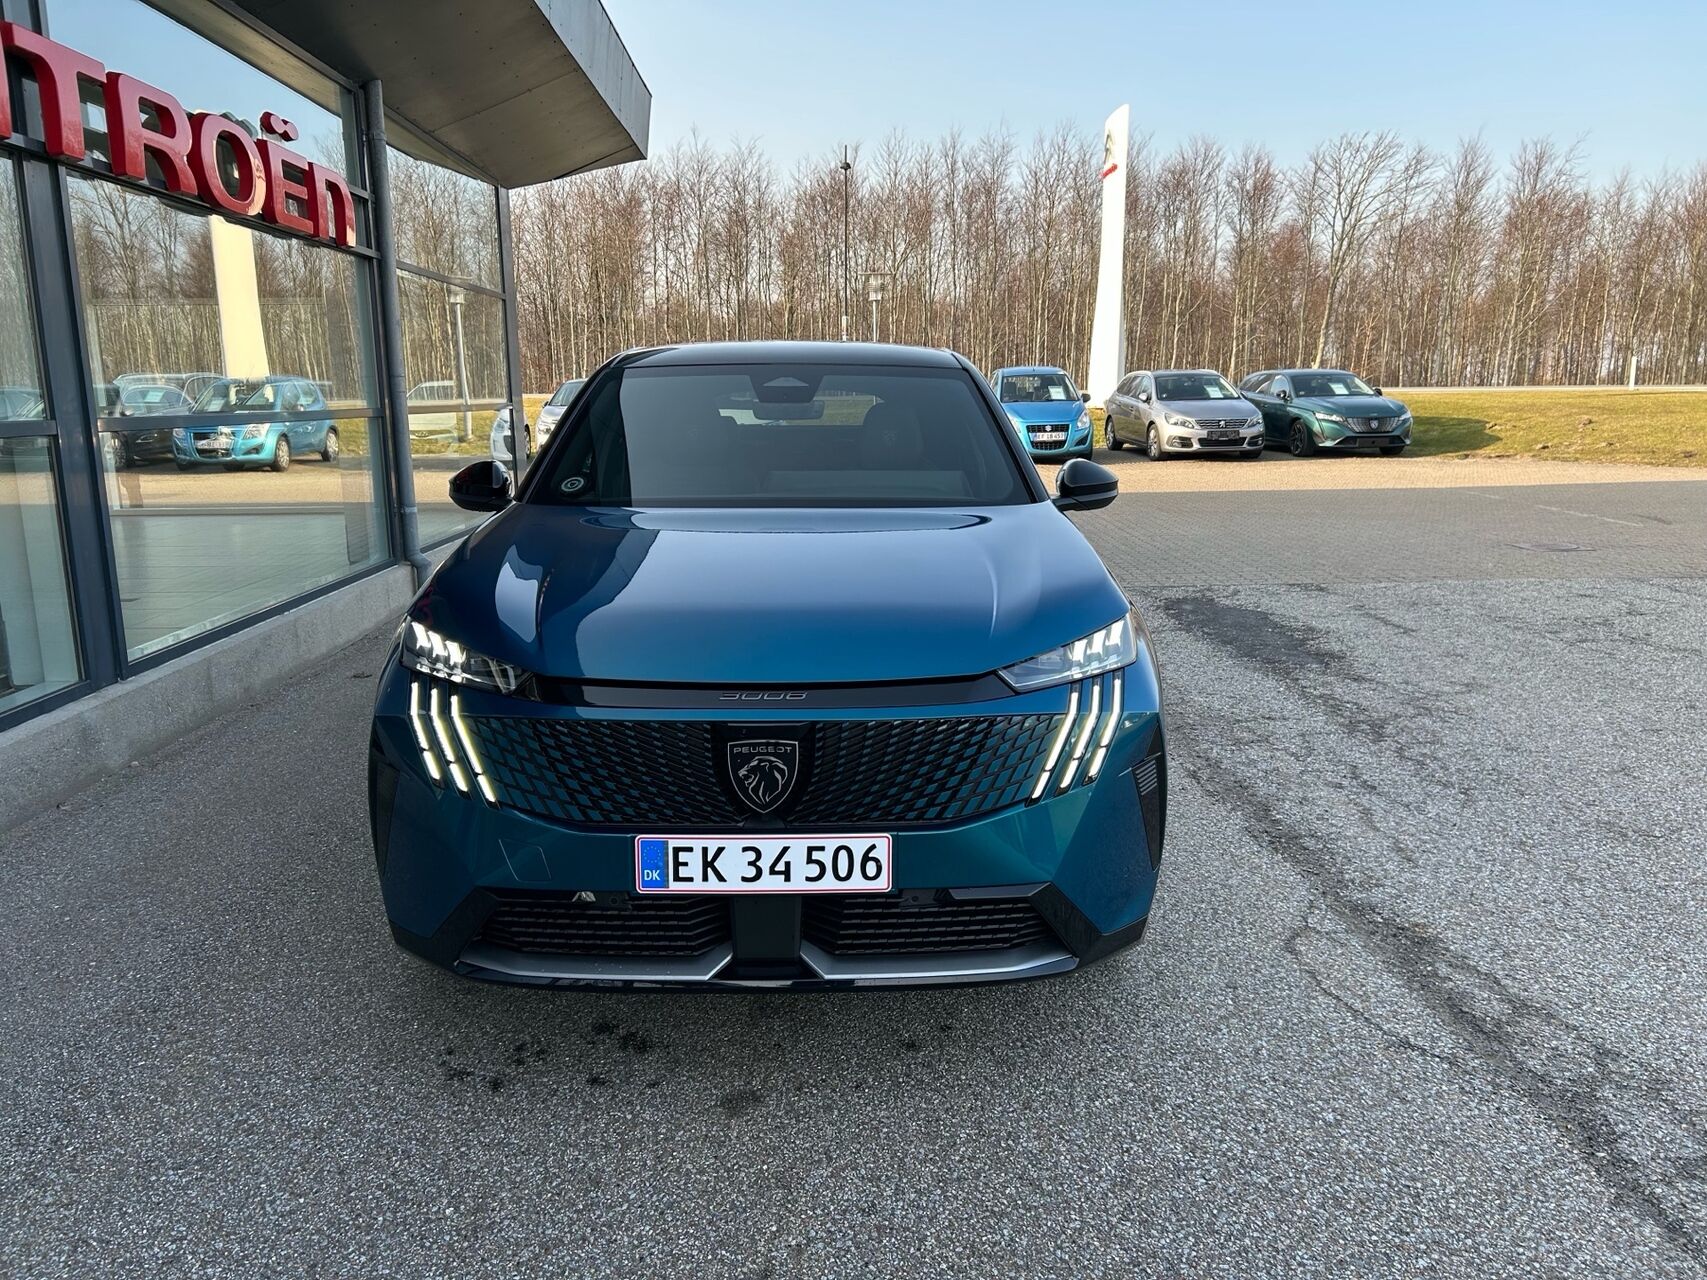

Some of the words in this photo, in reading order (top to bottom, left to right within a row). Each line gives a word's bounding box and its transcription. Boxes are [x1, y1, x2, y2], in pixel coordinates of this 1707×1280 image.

[720, 691, 808, 700] 3008
[733, 746, 793, 754] PEUGEOT
[672, 846, 727, 882] EK
[740, 846, 791, 882] 34
[804, 843, 883, 882] 506
[644, 870, 660, 880] DK
